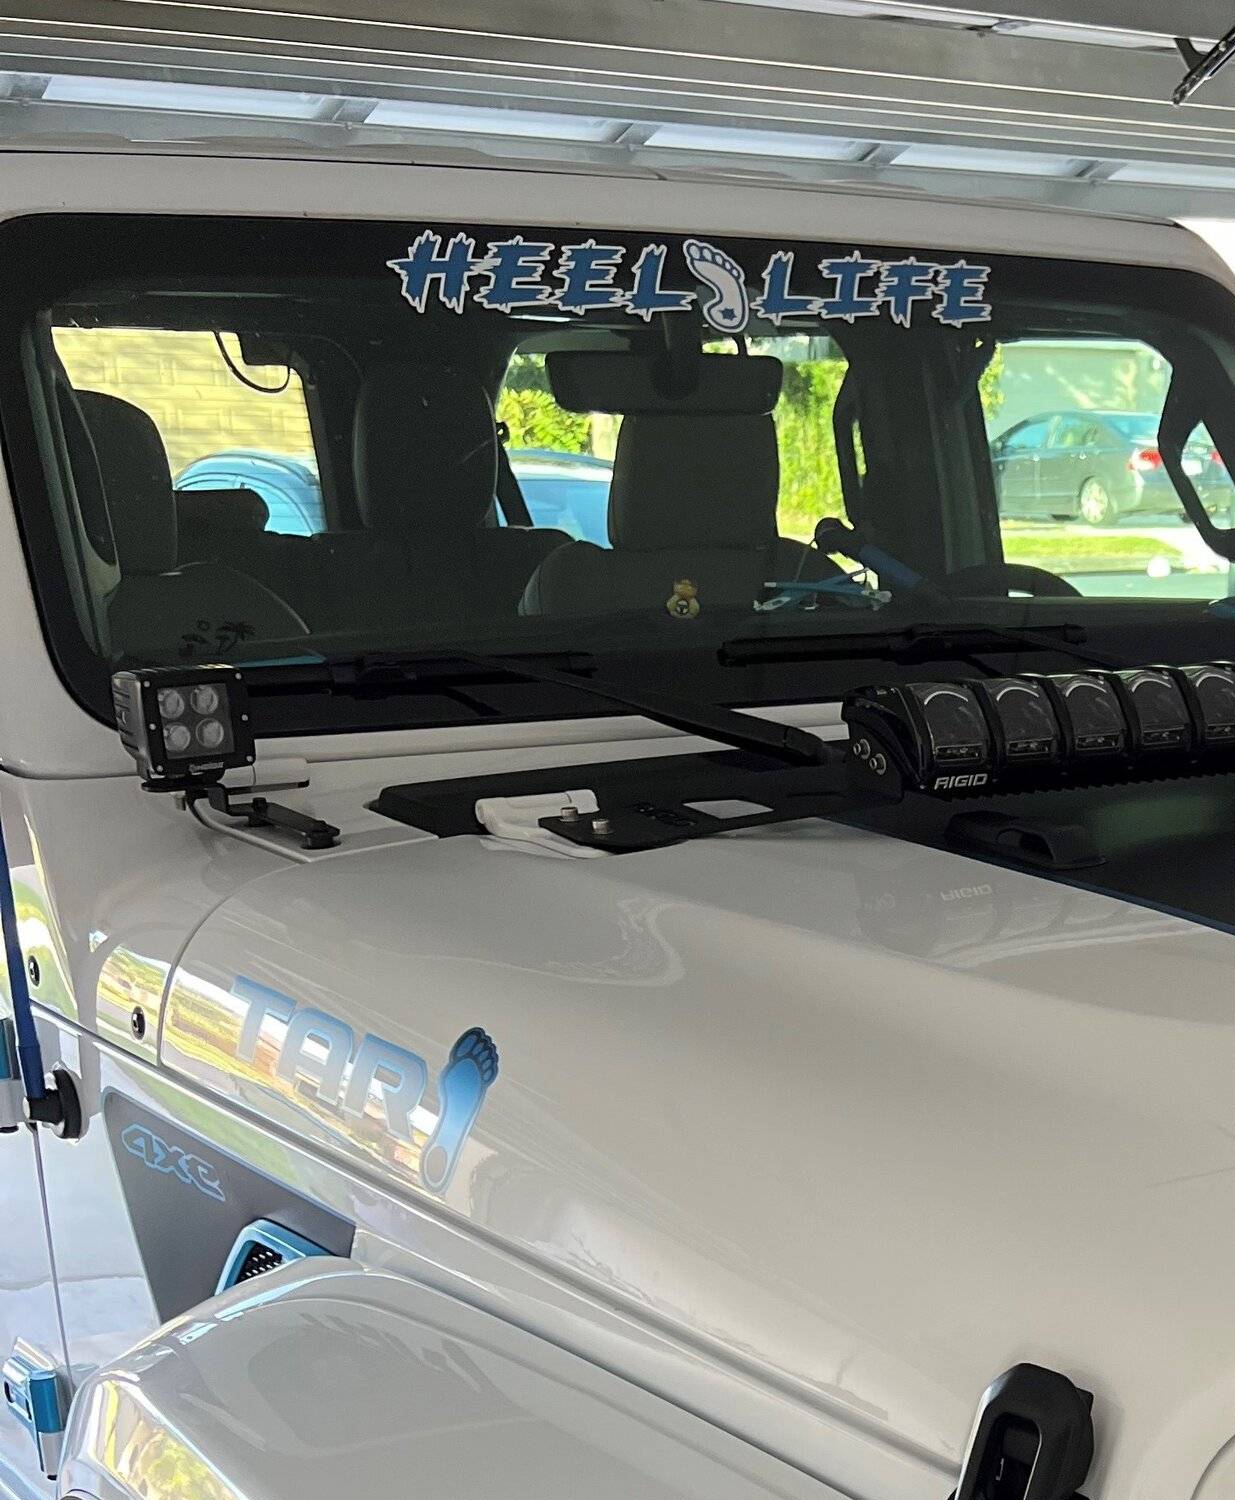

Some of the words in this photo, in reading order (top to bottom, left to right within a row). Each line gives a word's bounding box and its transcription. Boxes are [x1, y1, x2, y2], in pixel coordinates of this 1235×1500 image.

[386, 229, 698, 322] HEEL
[750, 249, 993, 329] LIFE
[934, 773, 989, 790] RIGID
[231, 974, 429, 1143] TAR
